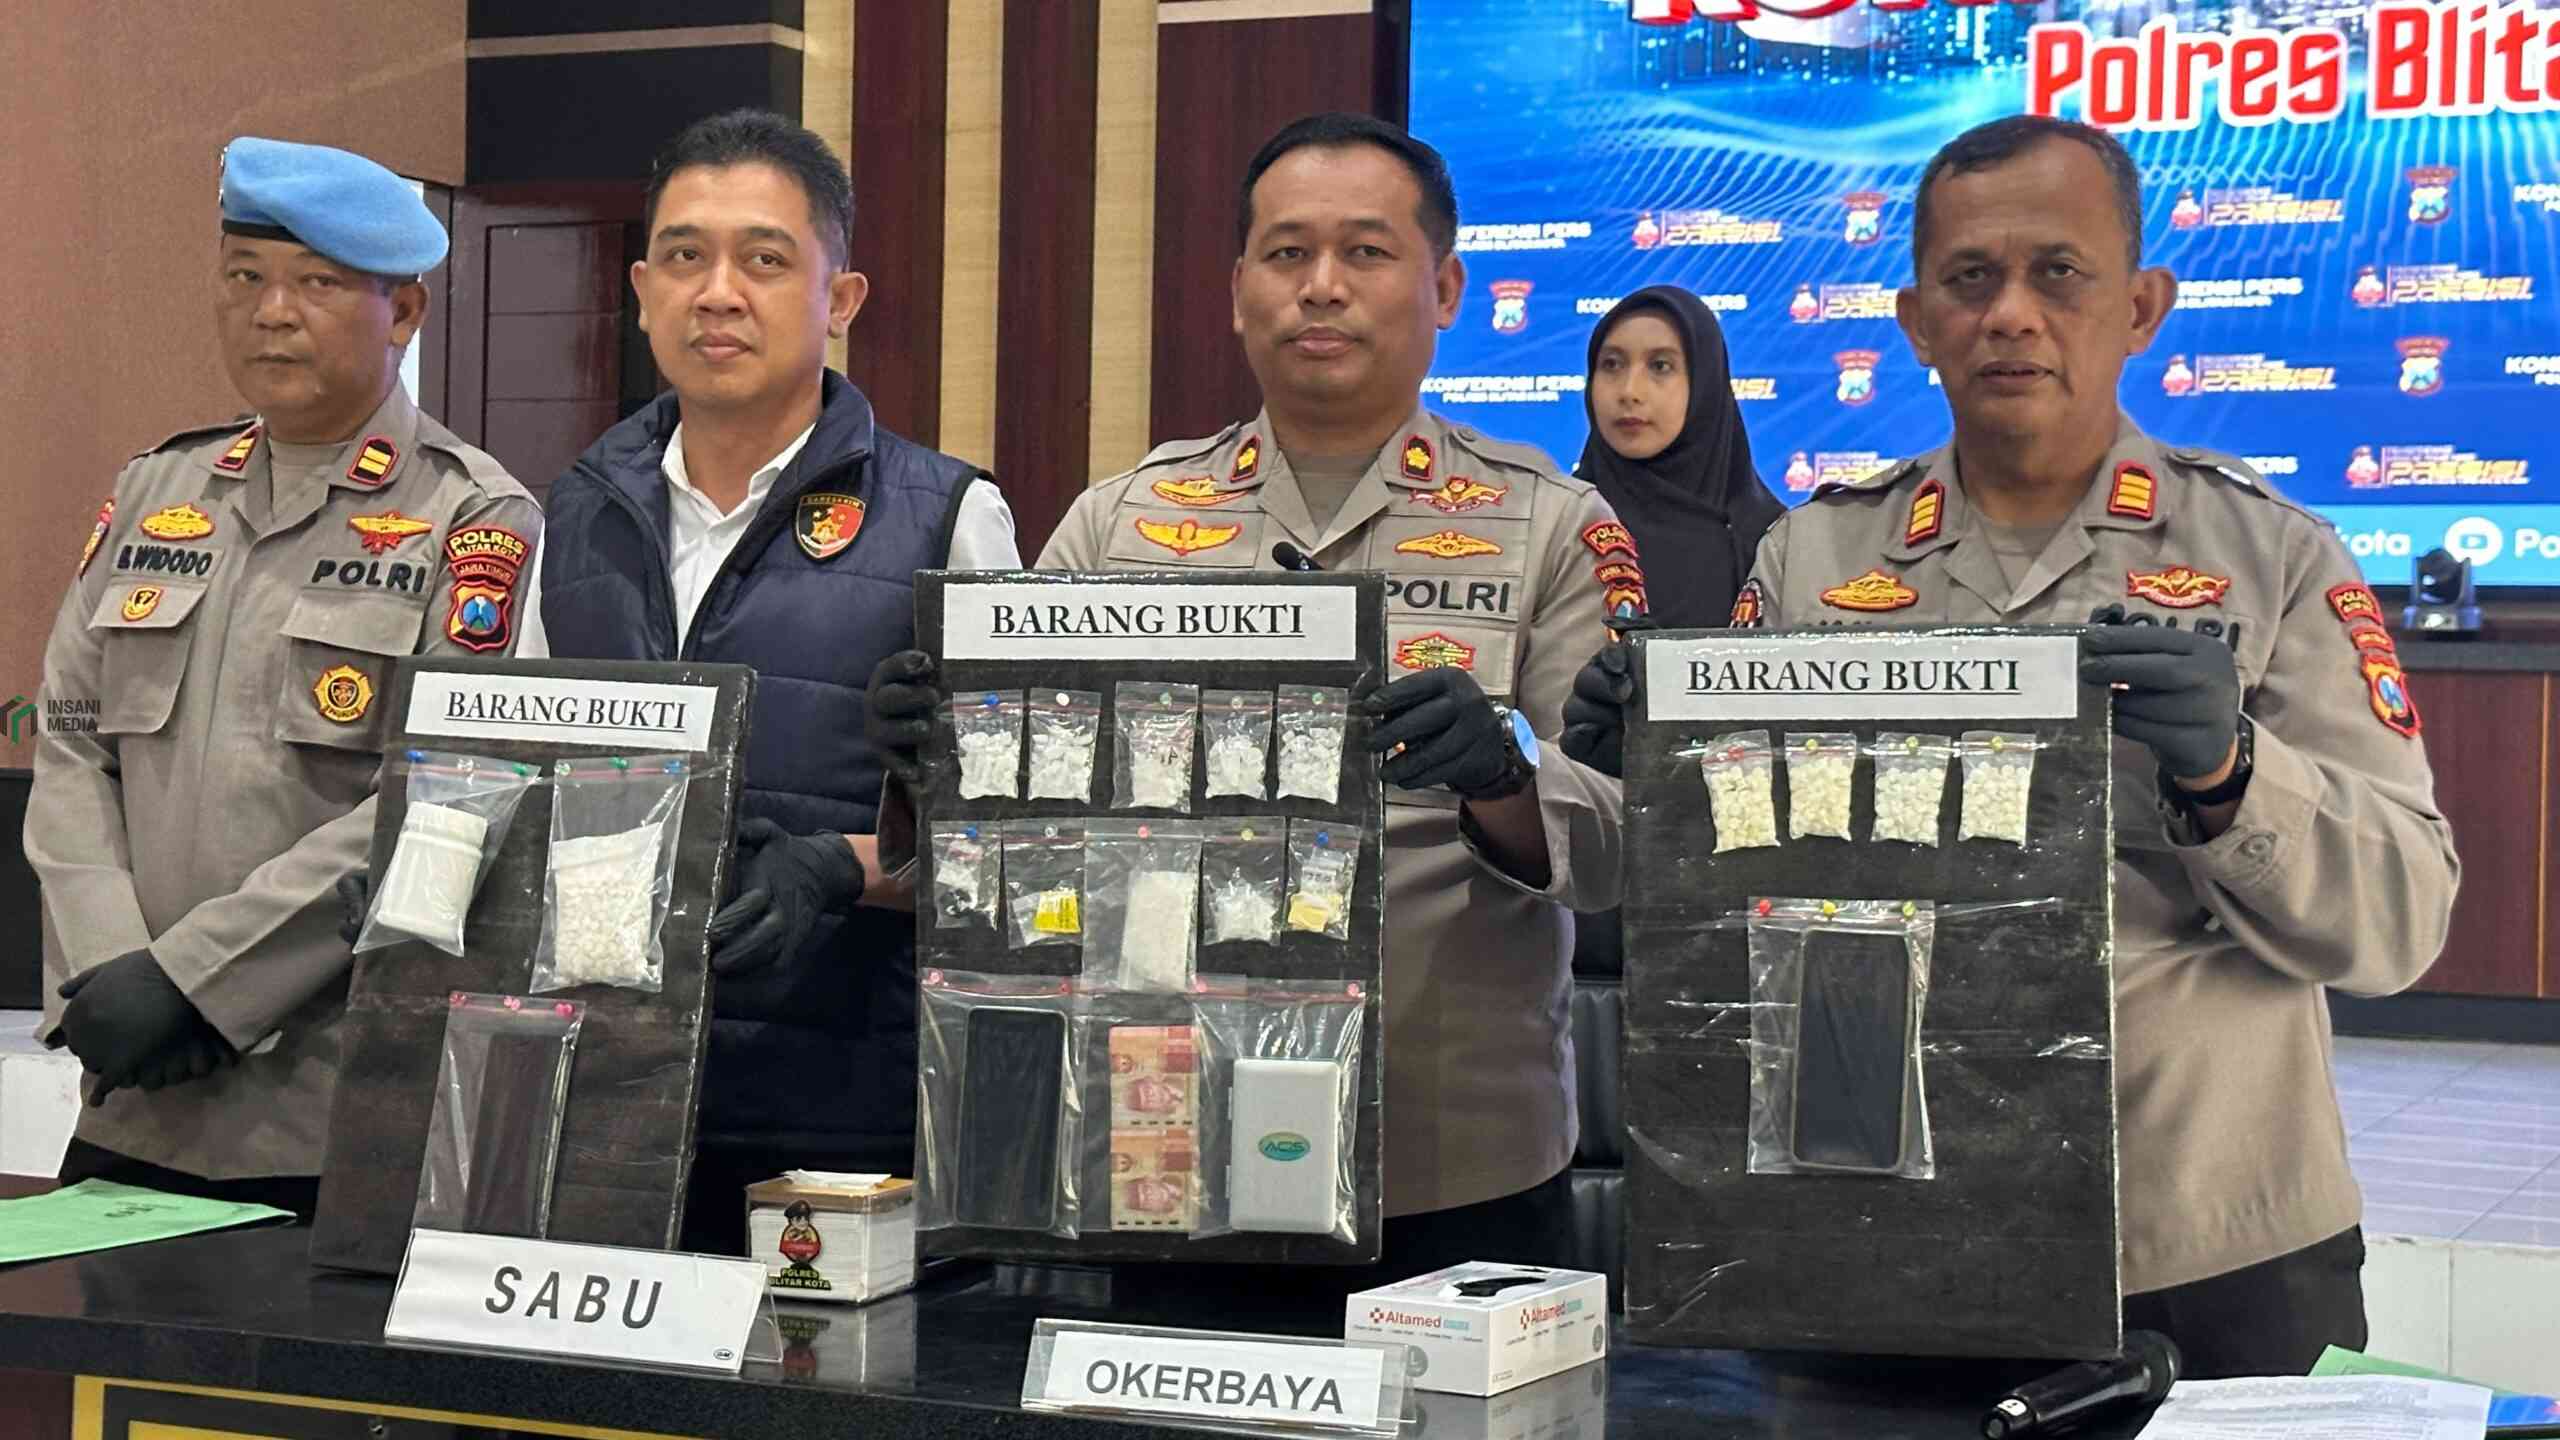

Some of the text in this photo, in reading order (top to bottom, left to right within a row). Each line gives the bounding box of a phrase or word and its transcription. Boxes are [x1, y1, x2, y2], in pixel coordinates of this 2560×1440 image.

[2030, 22, 2345, 129] Polres
[449, 530, 525, 555] POLRES
[311, 559, 427, 593] POLRI
[991, 603, 1304, 634] BARANG BUKTI
[1687, 660, 2019, 691] BARANG BUKTI
[446, 692, 686, 729] BARANG BUKTI
[781, 1268, 818, 1279] POLRES
[804, 1279, 831, 1289] KOTA
[484, 1265, 663, 1330] SABU
[1385, 1311, 1441, 1328] Altamed
[1087, 1360, 1344, 1414] OKERBAYA
